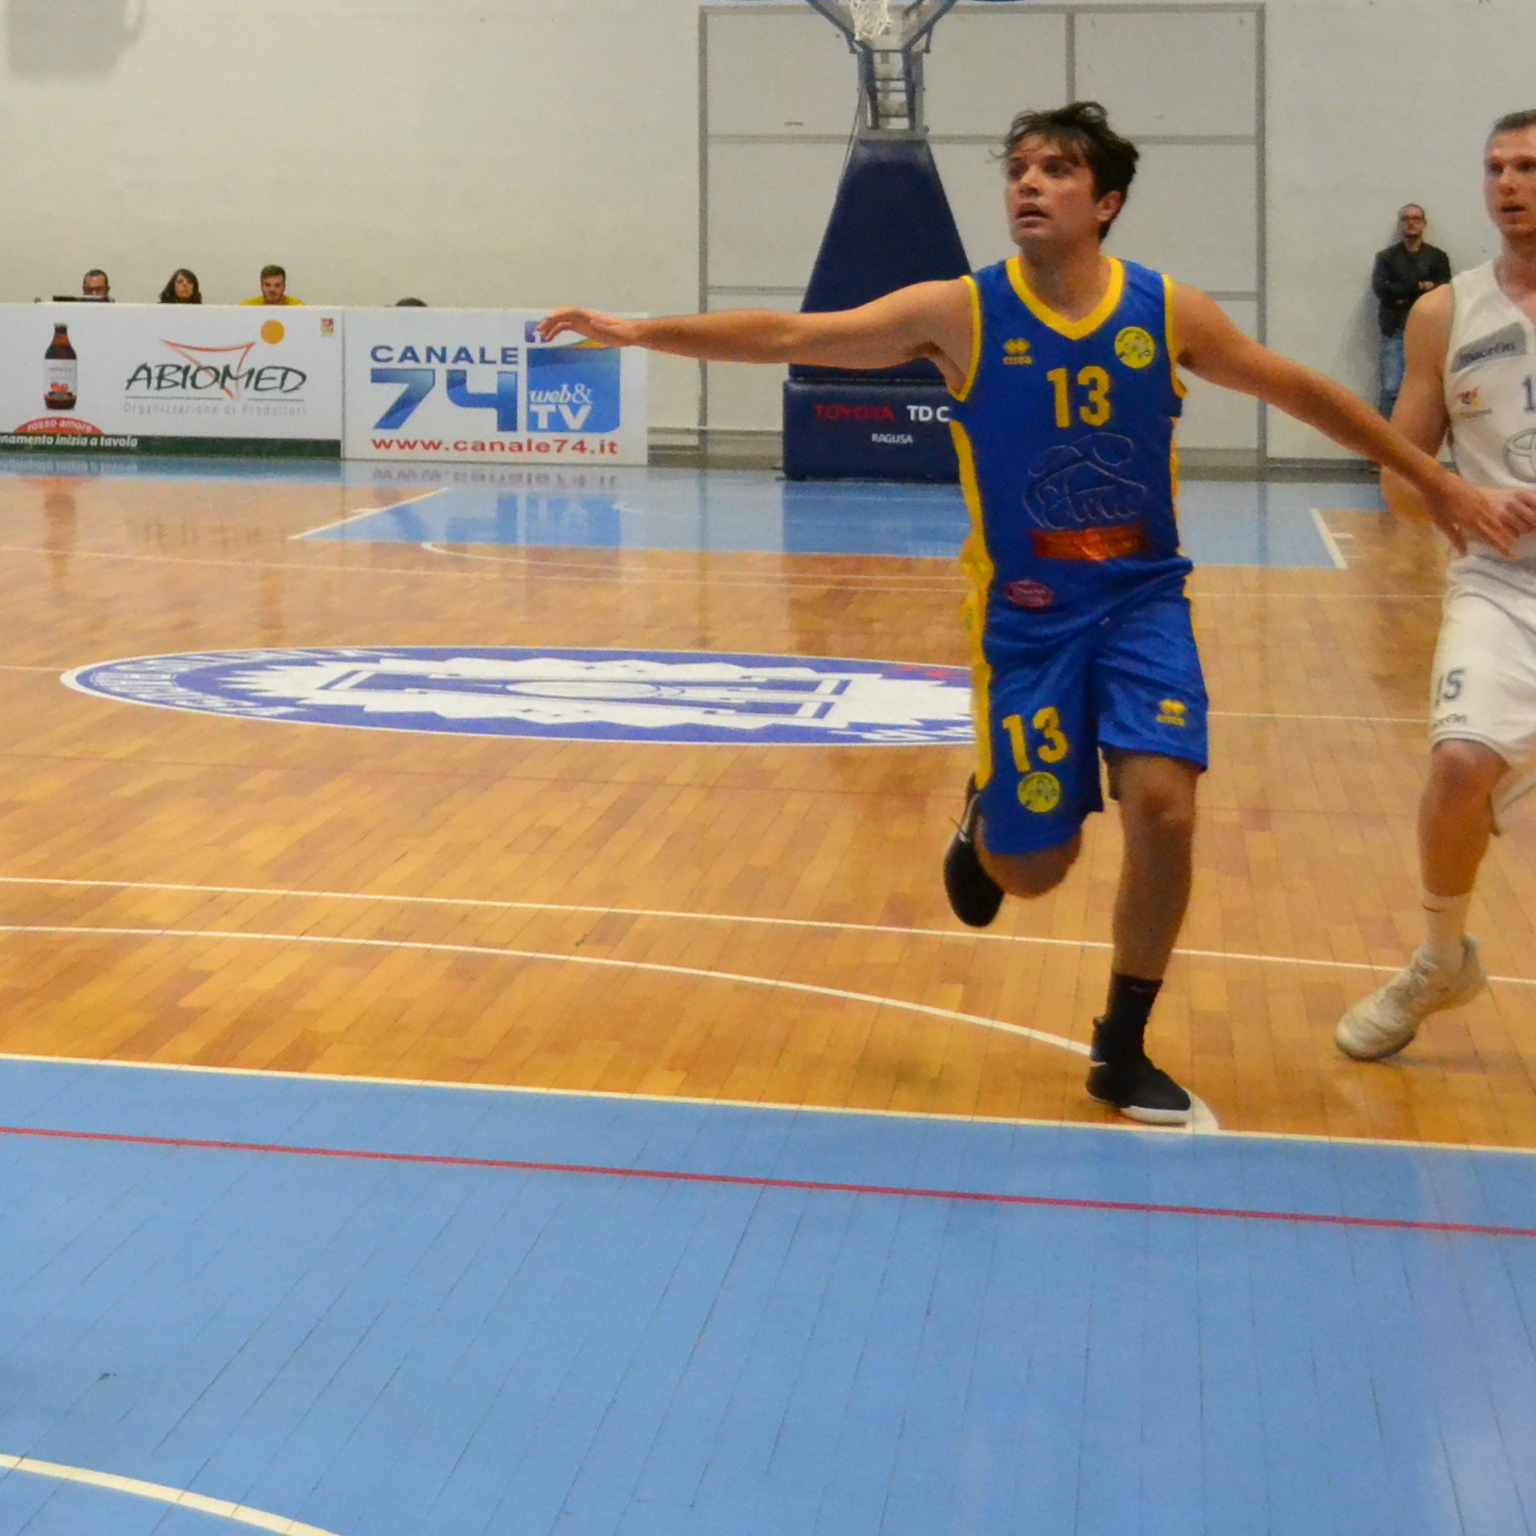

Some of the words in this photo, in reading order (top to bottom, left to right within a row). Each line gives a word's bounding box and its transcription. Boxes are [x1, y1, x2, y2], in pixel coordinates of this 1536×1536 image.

[370, 345, 520, 365] CANALE
[124, 362, 308, 394] ABIOMED
[369, 367, 520, 433] 74
[1046, 365, 1110, 428] 13
[530, 404, 593, 431] TV
[814, 404, 896, 421] TOYOTA
[906, 405, 933, 421] TD
[27, 417, 57, 431] rosso
[59, 419, 93, 432] amore
[55, 433, 88, 446] inizia
[100, 434, 138, 448] tavola
[370, 438, 619, 456] www.canale74.it
[871, 433, 914, 445] RAGUSA
[1002, 706, 1068, 773] 13
